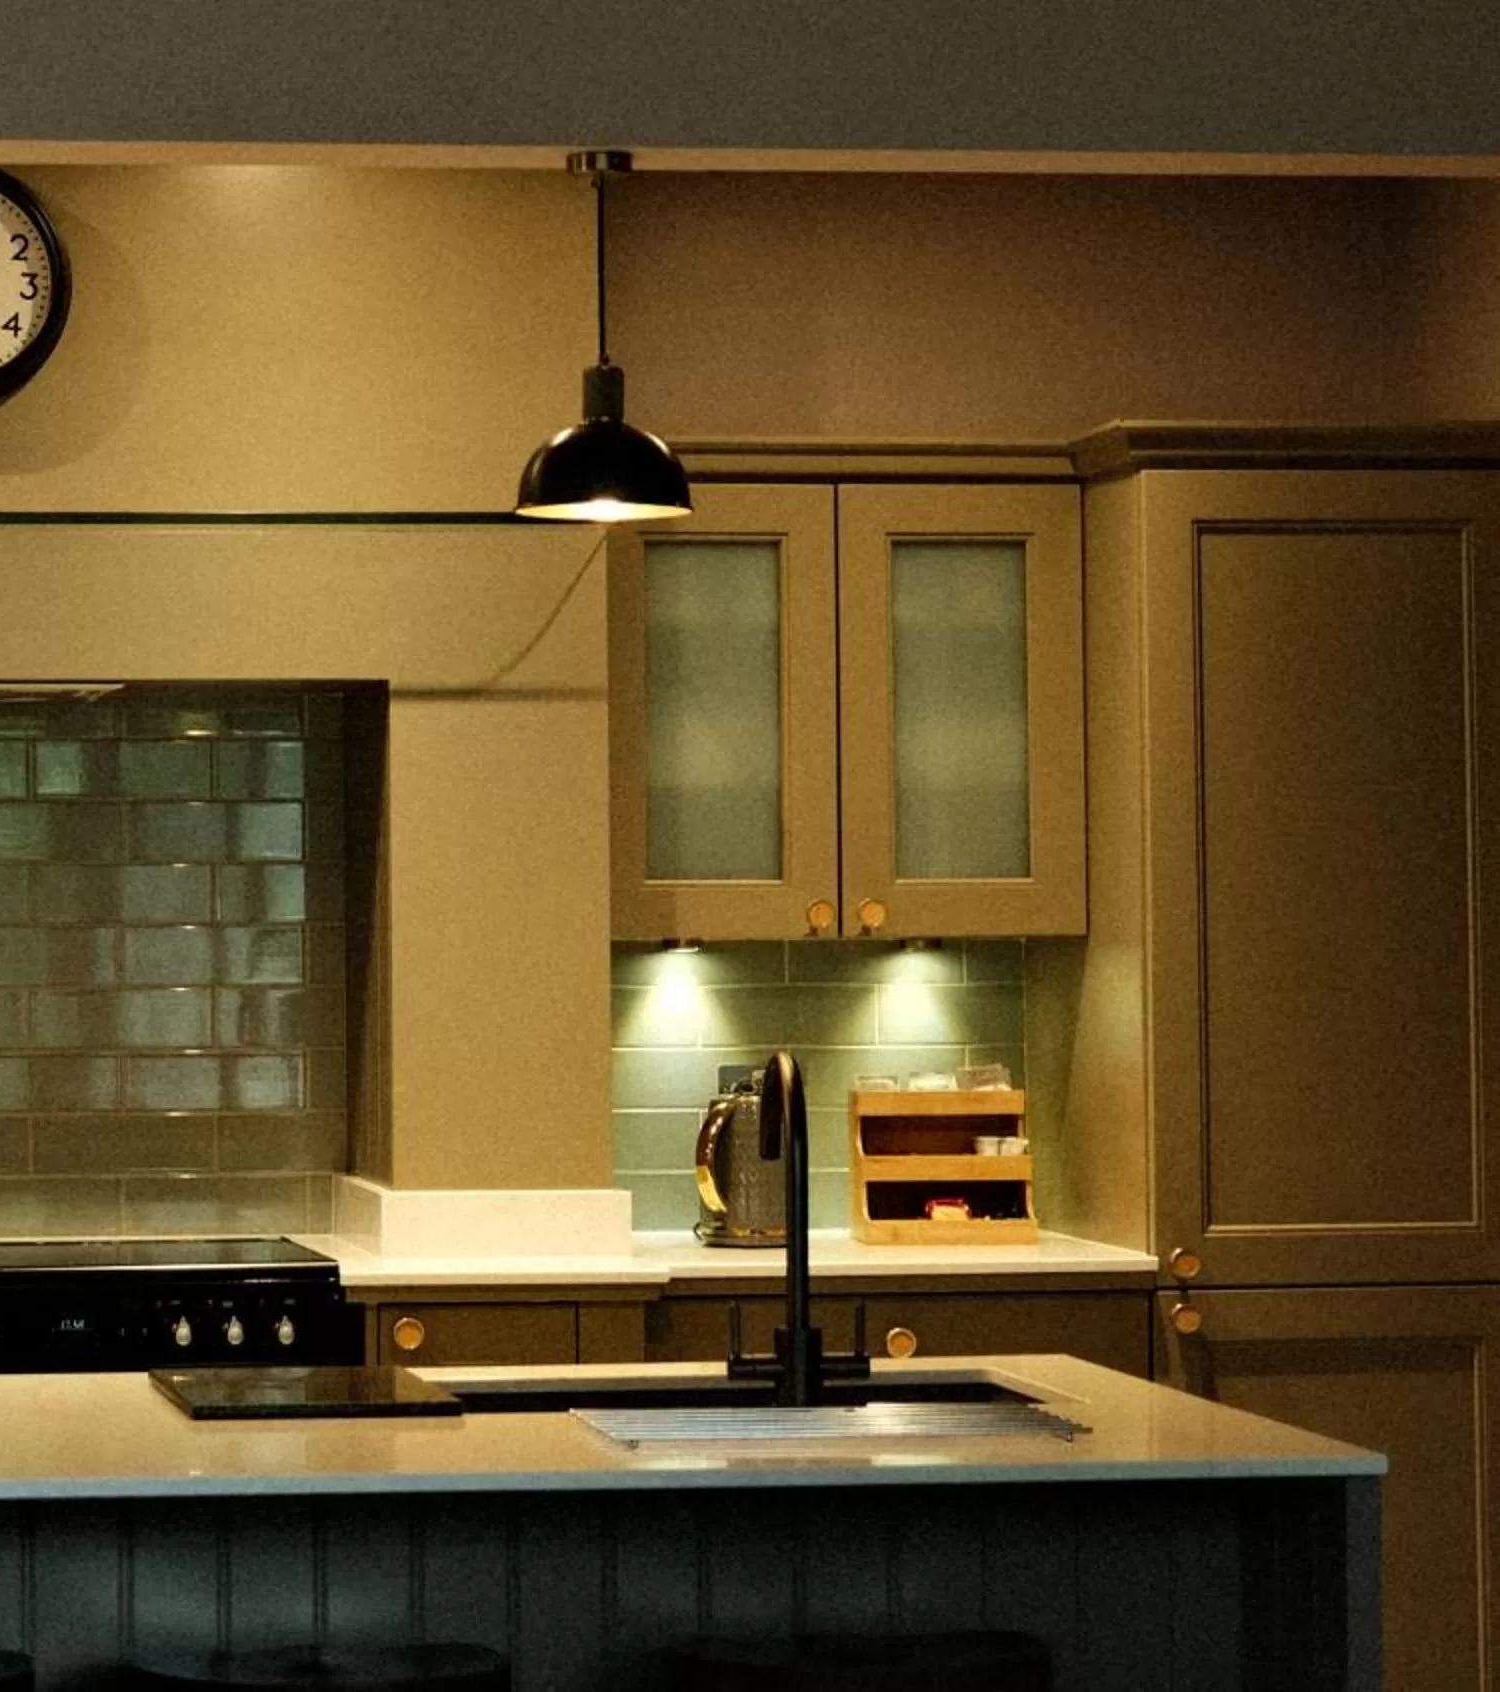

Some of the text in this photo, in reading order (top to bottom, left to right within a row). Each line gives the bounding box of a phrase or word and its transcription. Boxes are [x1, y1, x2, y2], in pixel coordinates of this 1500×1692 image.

[10, 234, 29, 261] 2
[20, 273, 38, 300] 3
[1, 312, 22, 338] 4
